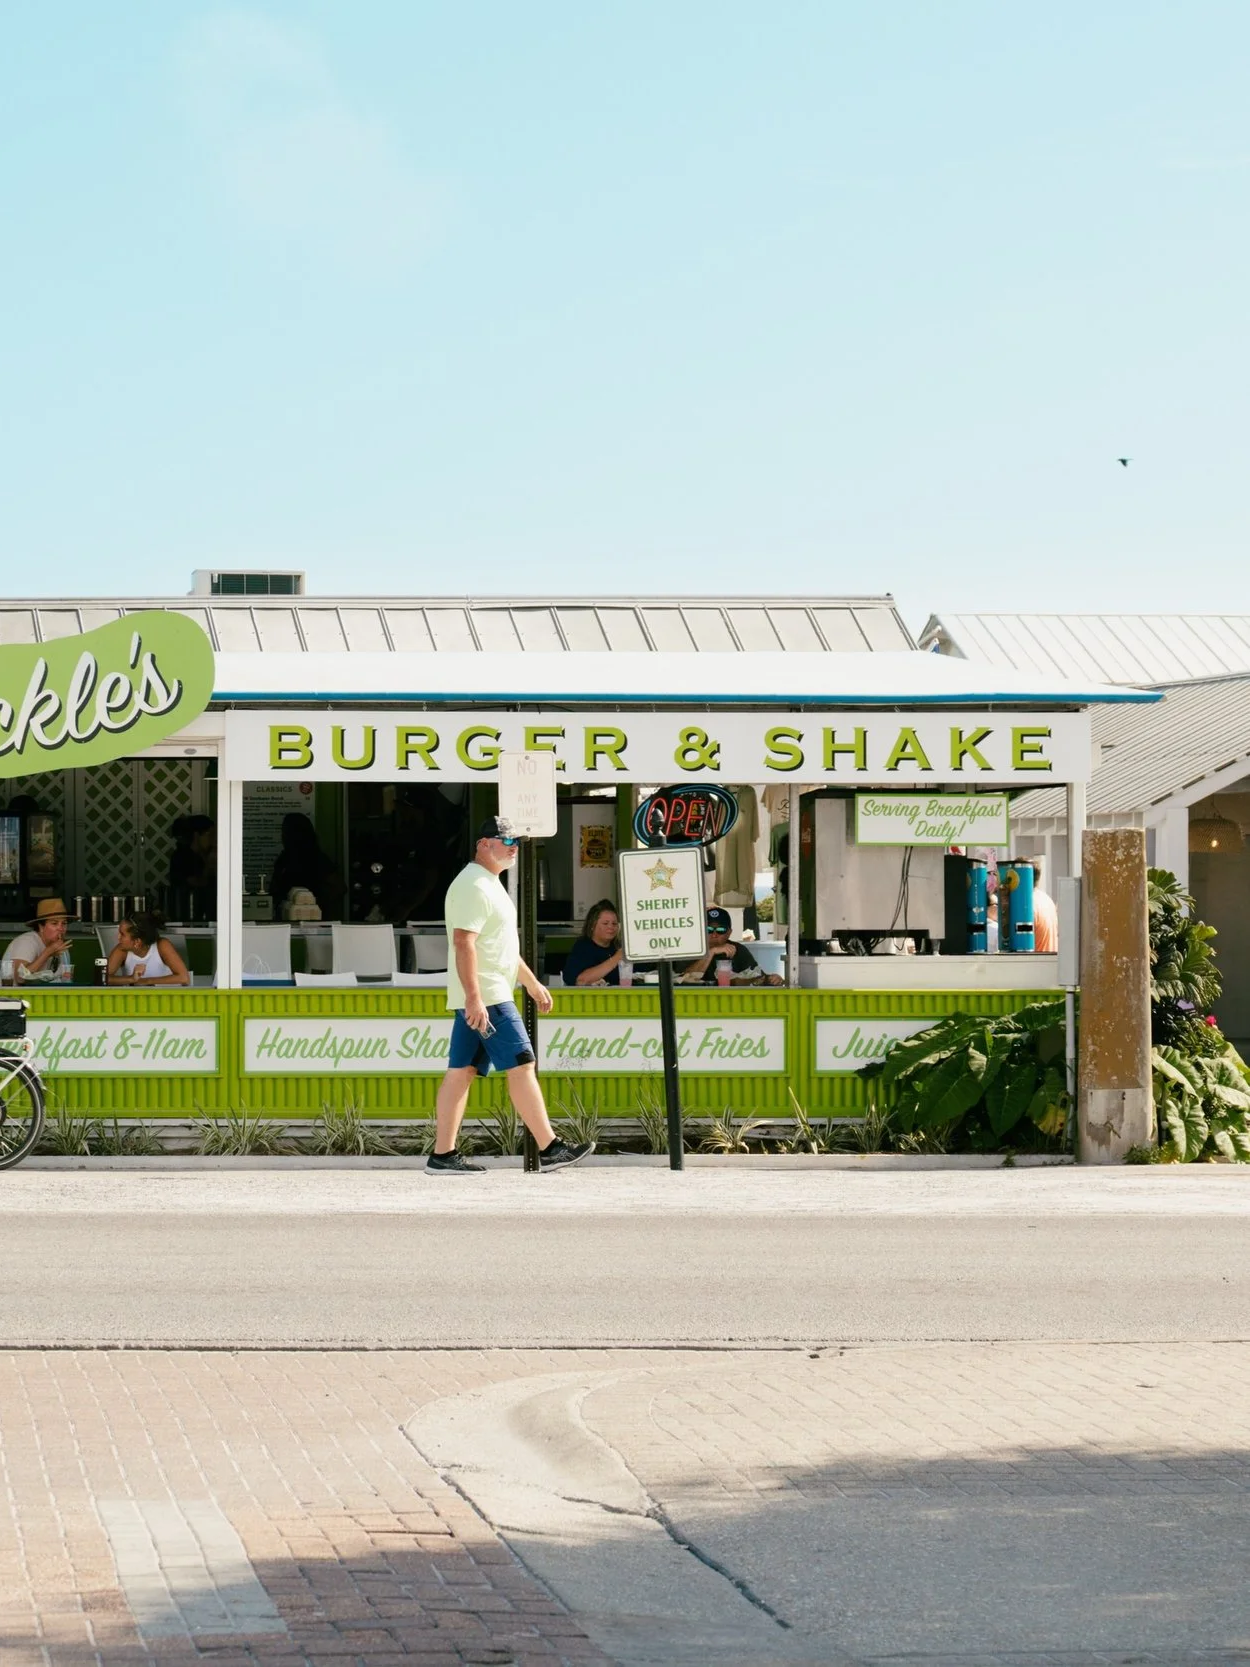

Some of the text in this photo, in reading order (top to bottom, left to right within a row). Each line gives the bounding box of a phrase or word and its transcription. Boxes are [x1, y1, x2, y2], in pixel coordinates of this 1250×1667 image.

[268, 725, 1052, 771] BURGER & SHAKE
[517, 760, 537, 776] NO
[517, 793, 538, 805] ANY
[517, 807, 539, 818] TIME
[646, 797, 724, 837] OPEN
[861, 799, 1003, 825] Serving Breakfast
[914, 820, 966, 844] Daily!
[636, 897, 690, 912] SHERIFF
[633, 916, 695, 931] VEHICLES
[648, 936, 682, 949] ONLY
[113, 1027, 208, 1060] 8-11am
[255, 1024, 390, 1068] Handspun
[695, 1026, 771, 1060] Fries
